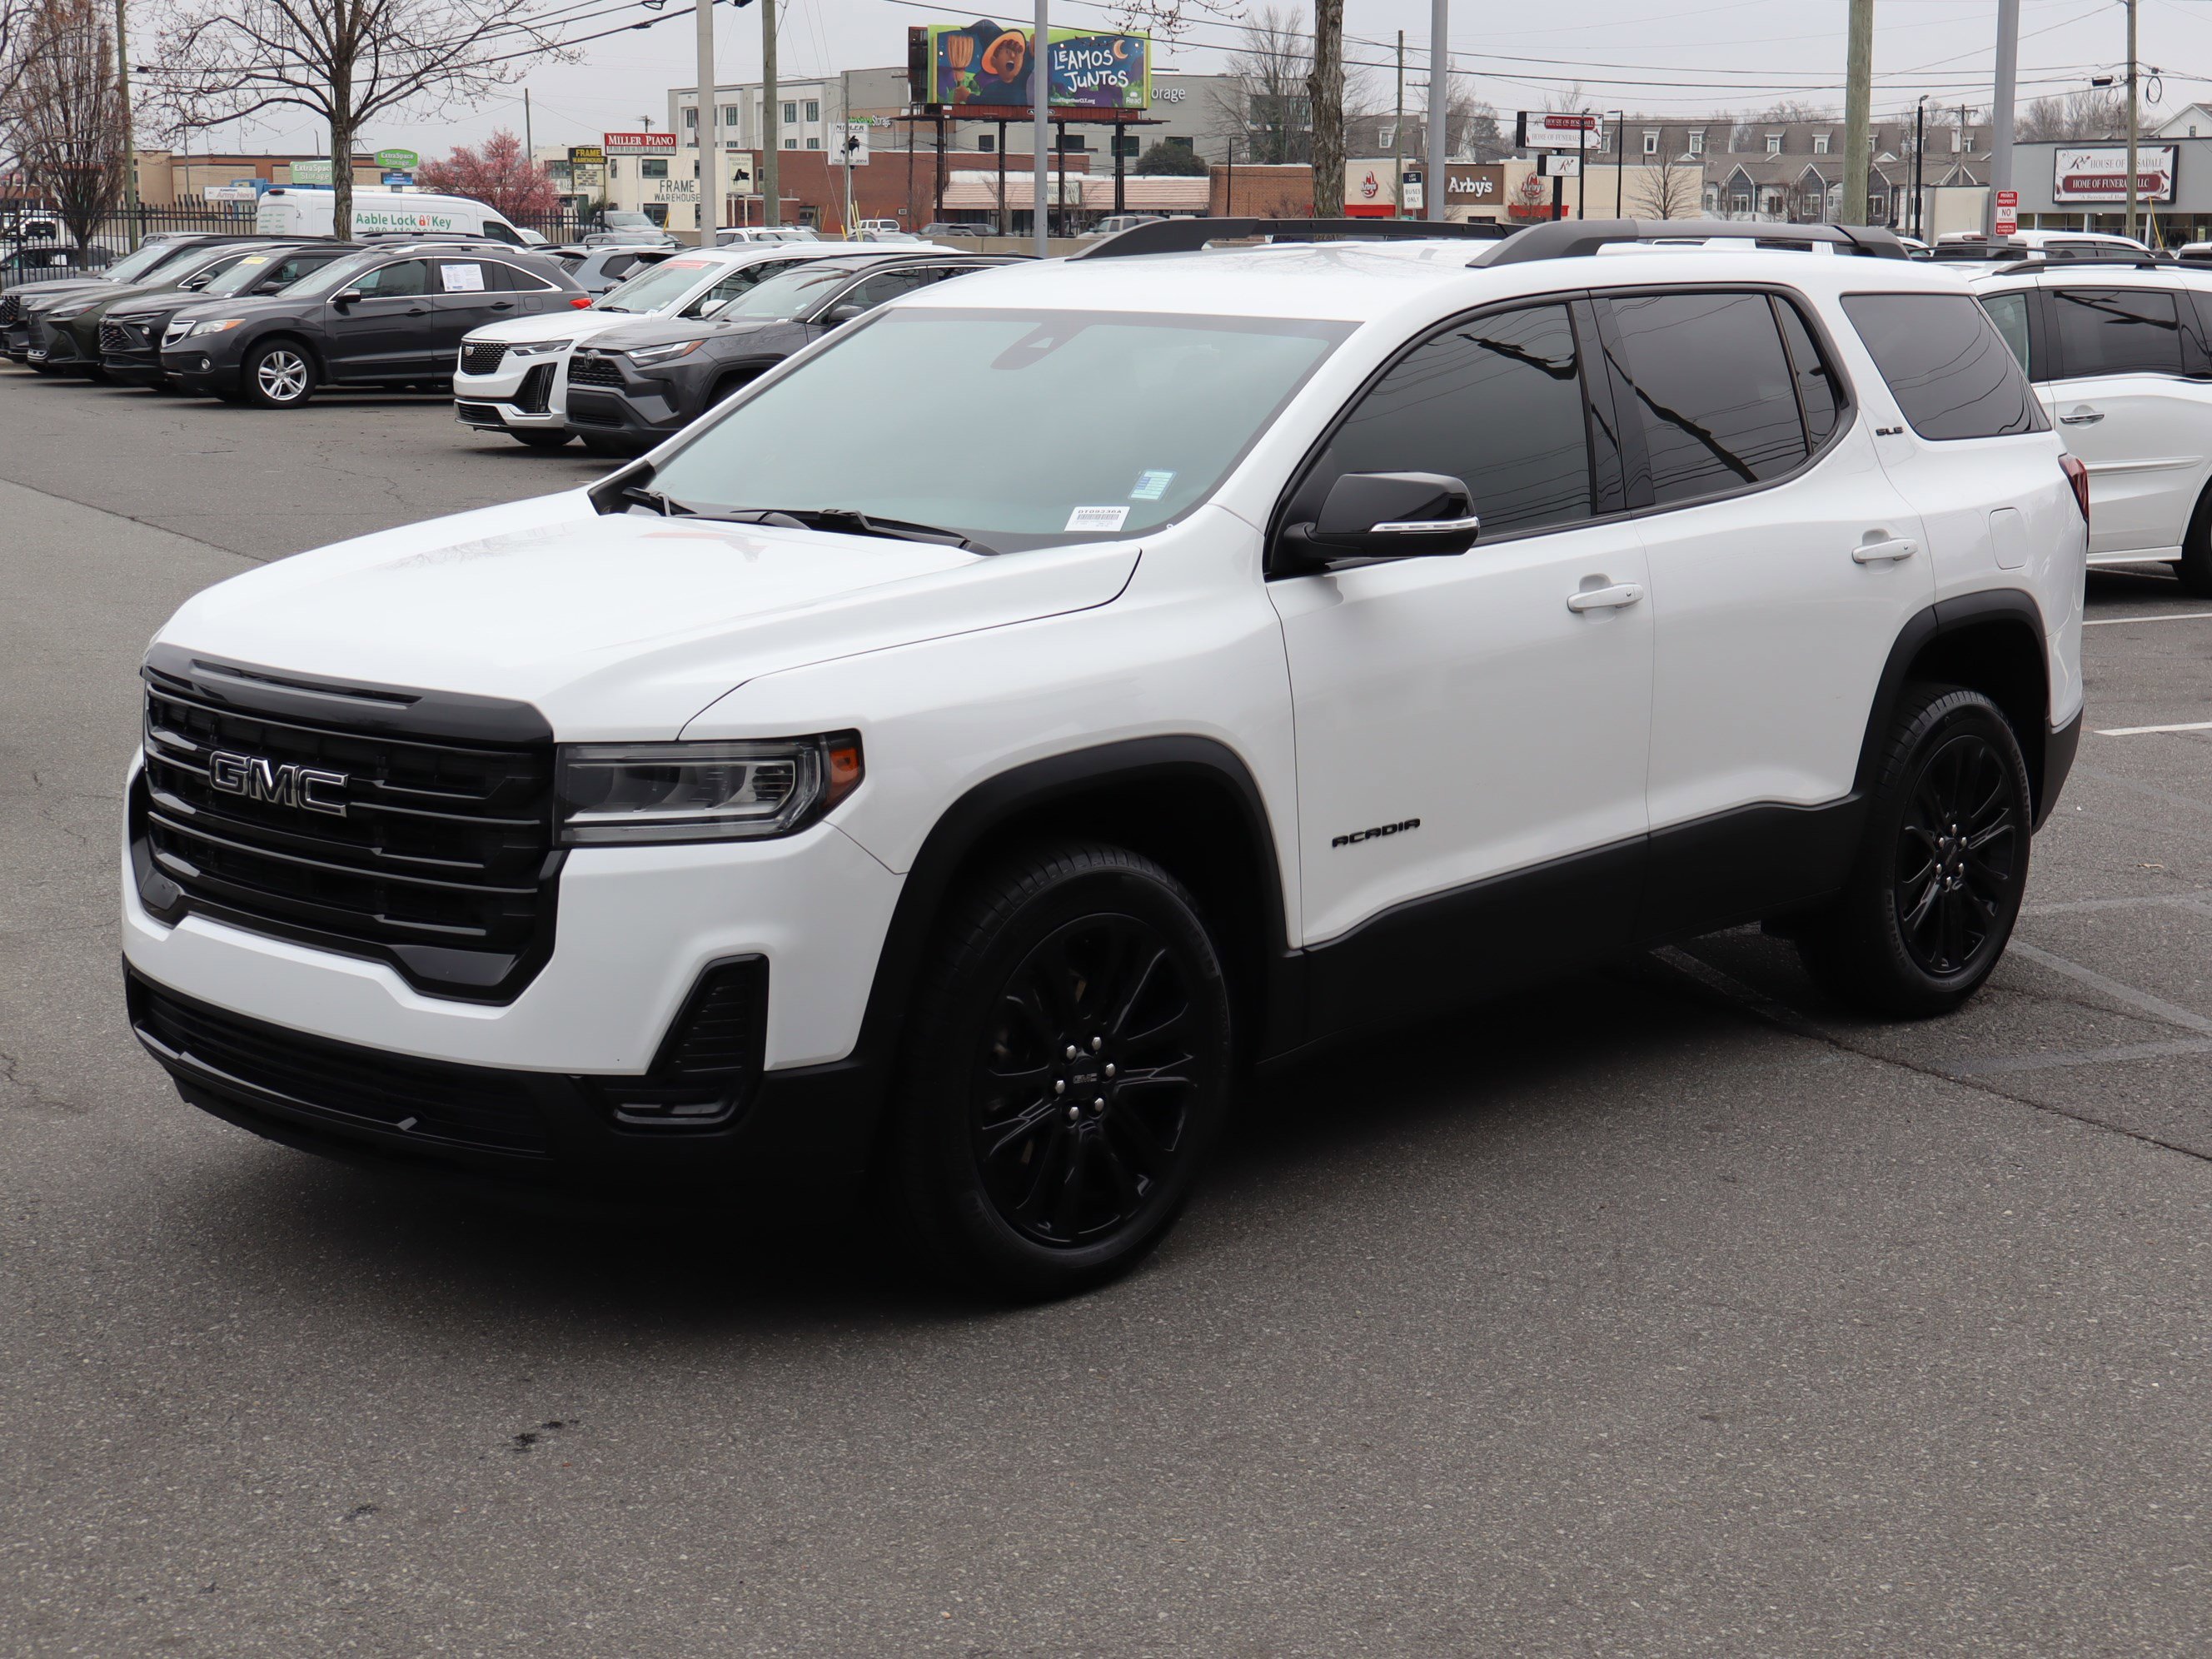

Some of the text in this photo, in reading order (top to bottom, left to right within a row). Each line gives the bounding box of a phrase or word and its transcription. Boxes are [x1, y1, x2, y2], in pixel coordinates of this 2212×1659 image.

[1054, 49, 1114, 71] LEAMOS
[1151, 87, 1186, 102] orage
[1125, 97, 1143, 105] Read
[608, 135, 674, 146] MILLER PIANO
[575, 149, 601, 157] FRAME
[386, 158, 411, 167] Storage
[2090, 159, 2113, 169] HOUSE
[2116, 159, 2125, 167] OF
[2137, 157, 2164, 167] SADALE
[300, 172, 330, 182] Storage
[2073, 177, 2150, 188] HOME OF FUNERA LLC
[660, 180, 695, 192] FRAME
[1448, 177, 1492, 197] Arby's
[655, 193, 700, 202] WAREHOUSE
[2001, 208, 2011, 217] NO
[356, 213, 388, 225] Aable
[391, 215, 416, 226] Lock
[431, 216, 452, 230] Key
[1876, 426, 1904, 436] SLE
[209, 750, 350, 818] GMC
[1332, 818, 1421, 848] ACADIA
[1073, 1073, 1098, 1084] GMC
